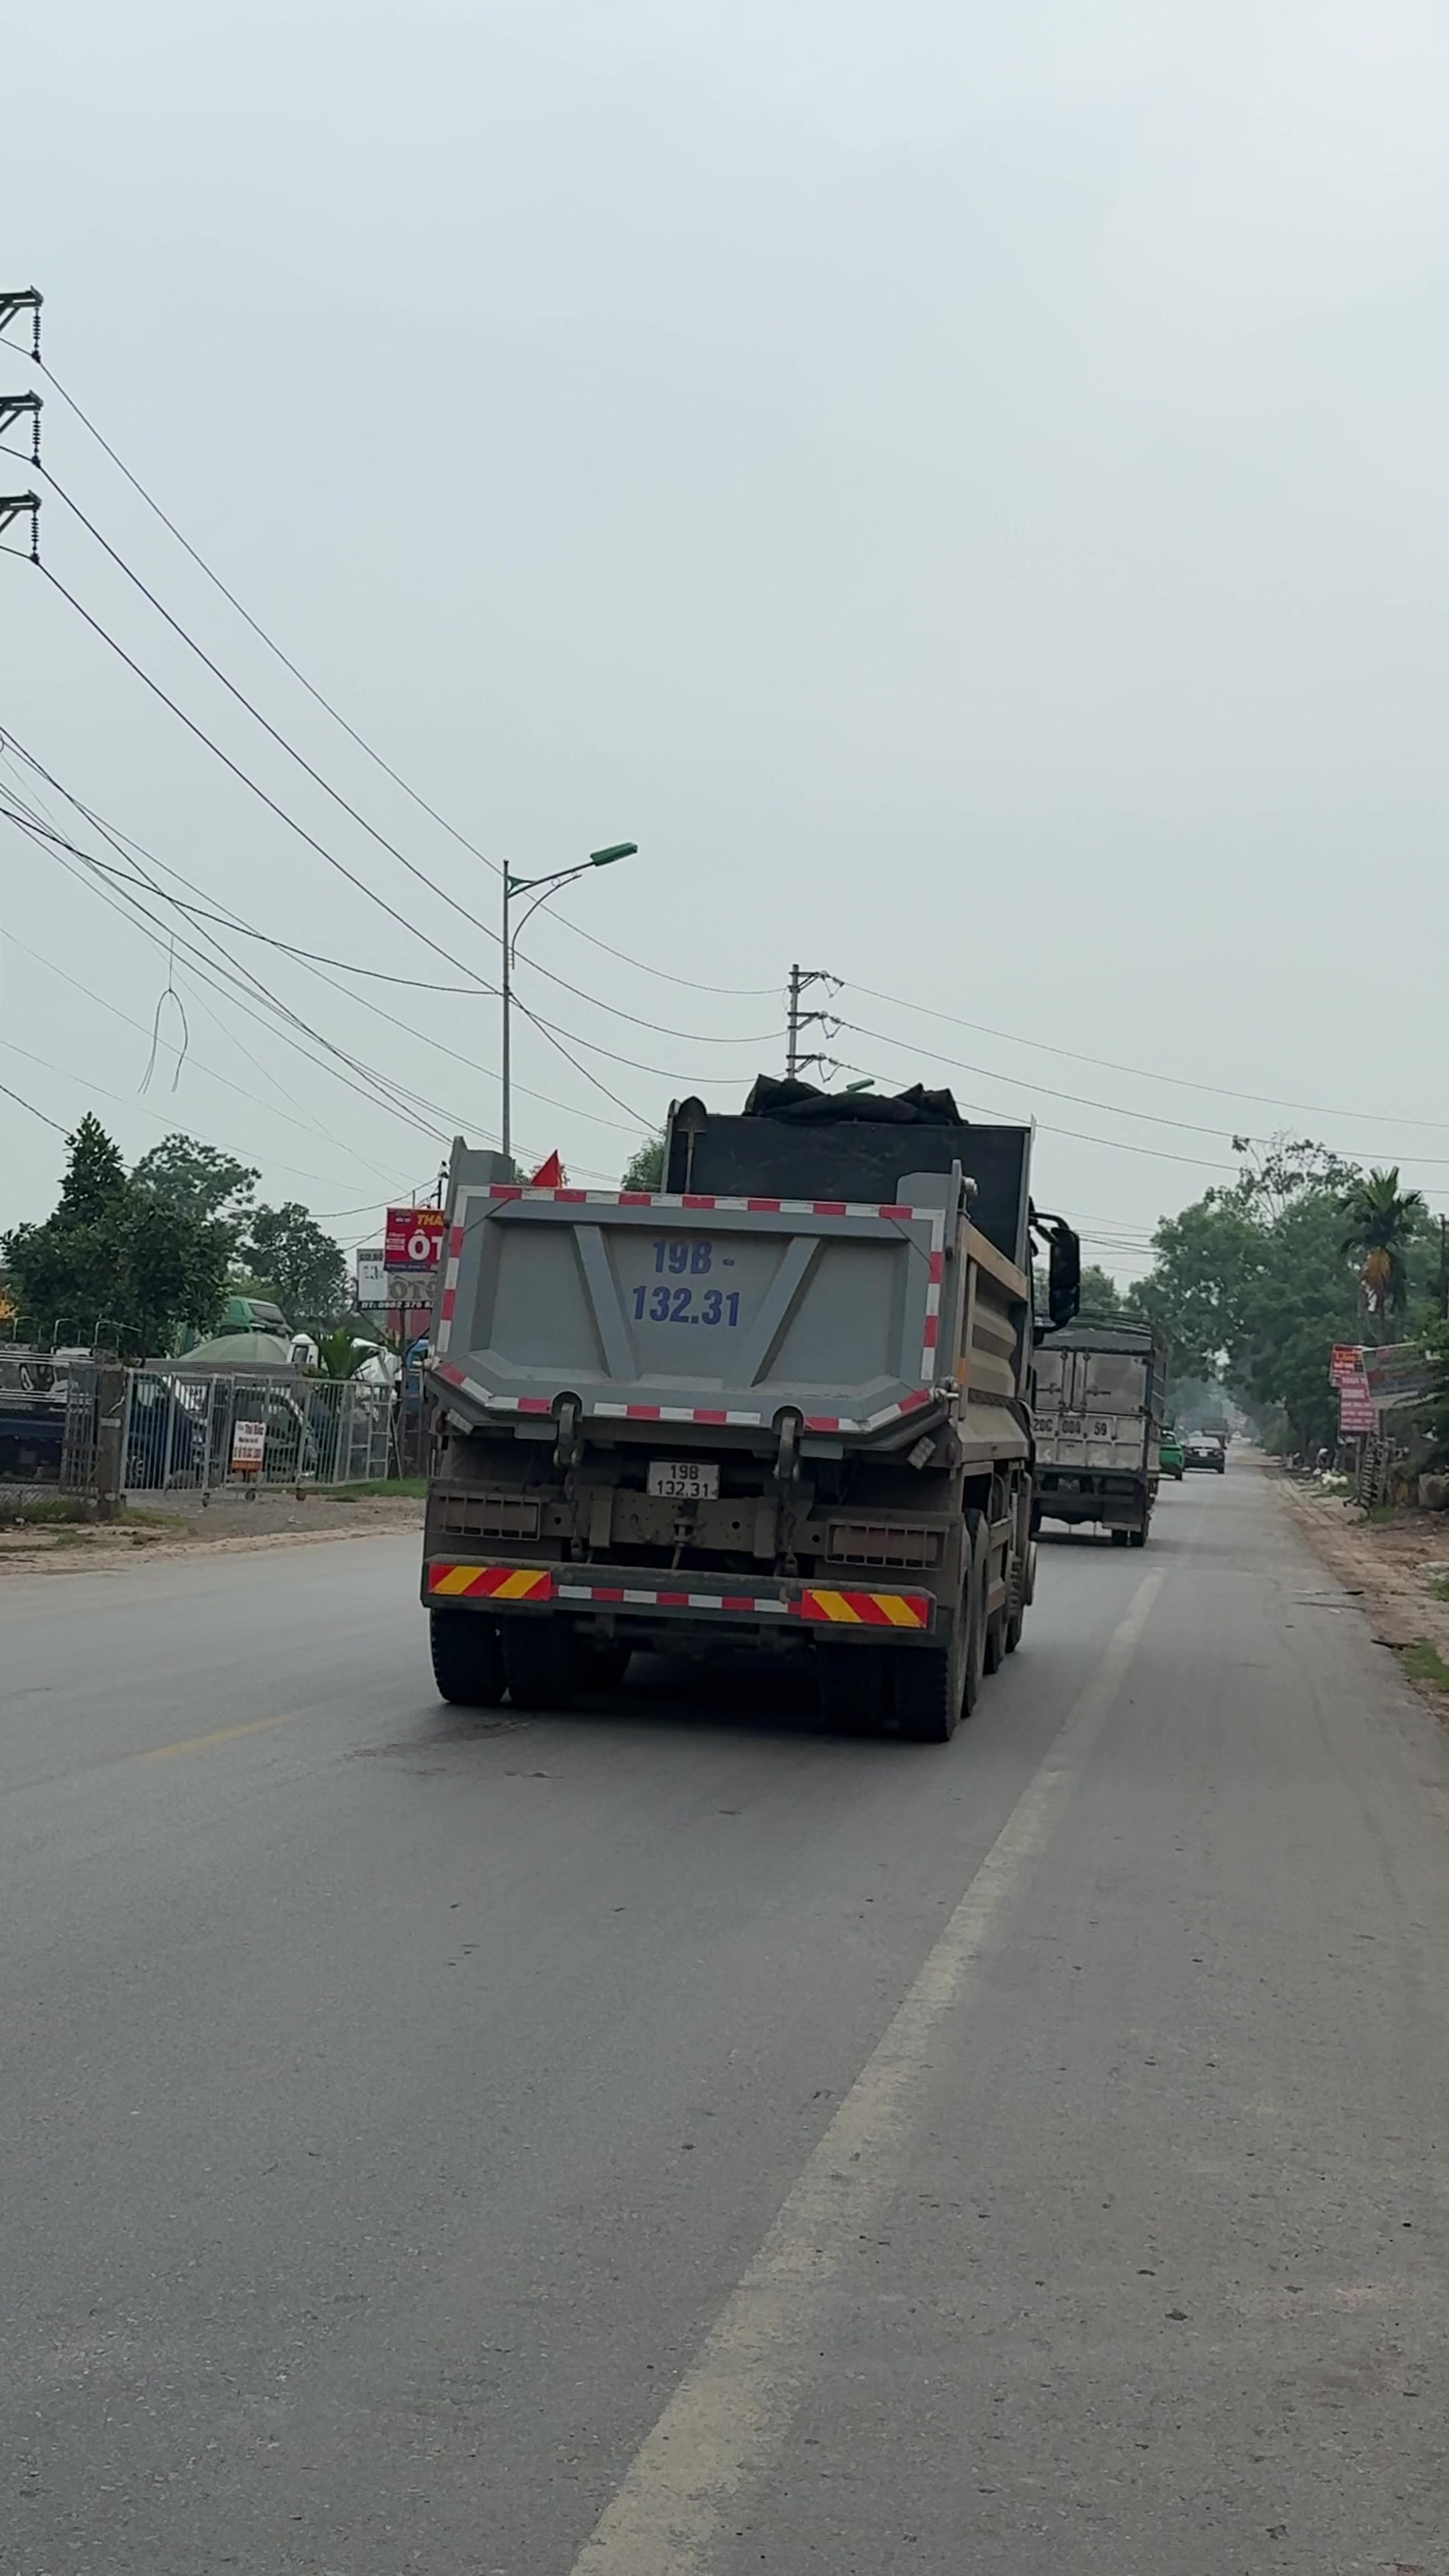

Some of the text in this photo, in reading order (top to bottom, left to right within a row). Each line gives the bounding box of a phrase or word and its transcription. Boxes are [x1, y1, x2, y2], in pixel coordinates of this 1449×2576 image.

[653, 1240, 713, 1275] 19B
[633, 1285, 741, 1327] 132.31
[1033, 1417, 1053, 1432] 20C
[1094, 1421, 1108, 1436] 59
[671, 1464, 700, 1481] 19B
[657, 1480, 709, 1498] 132.31
